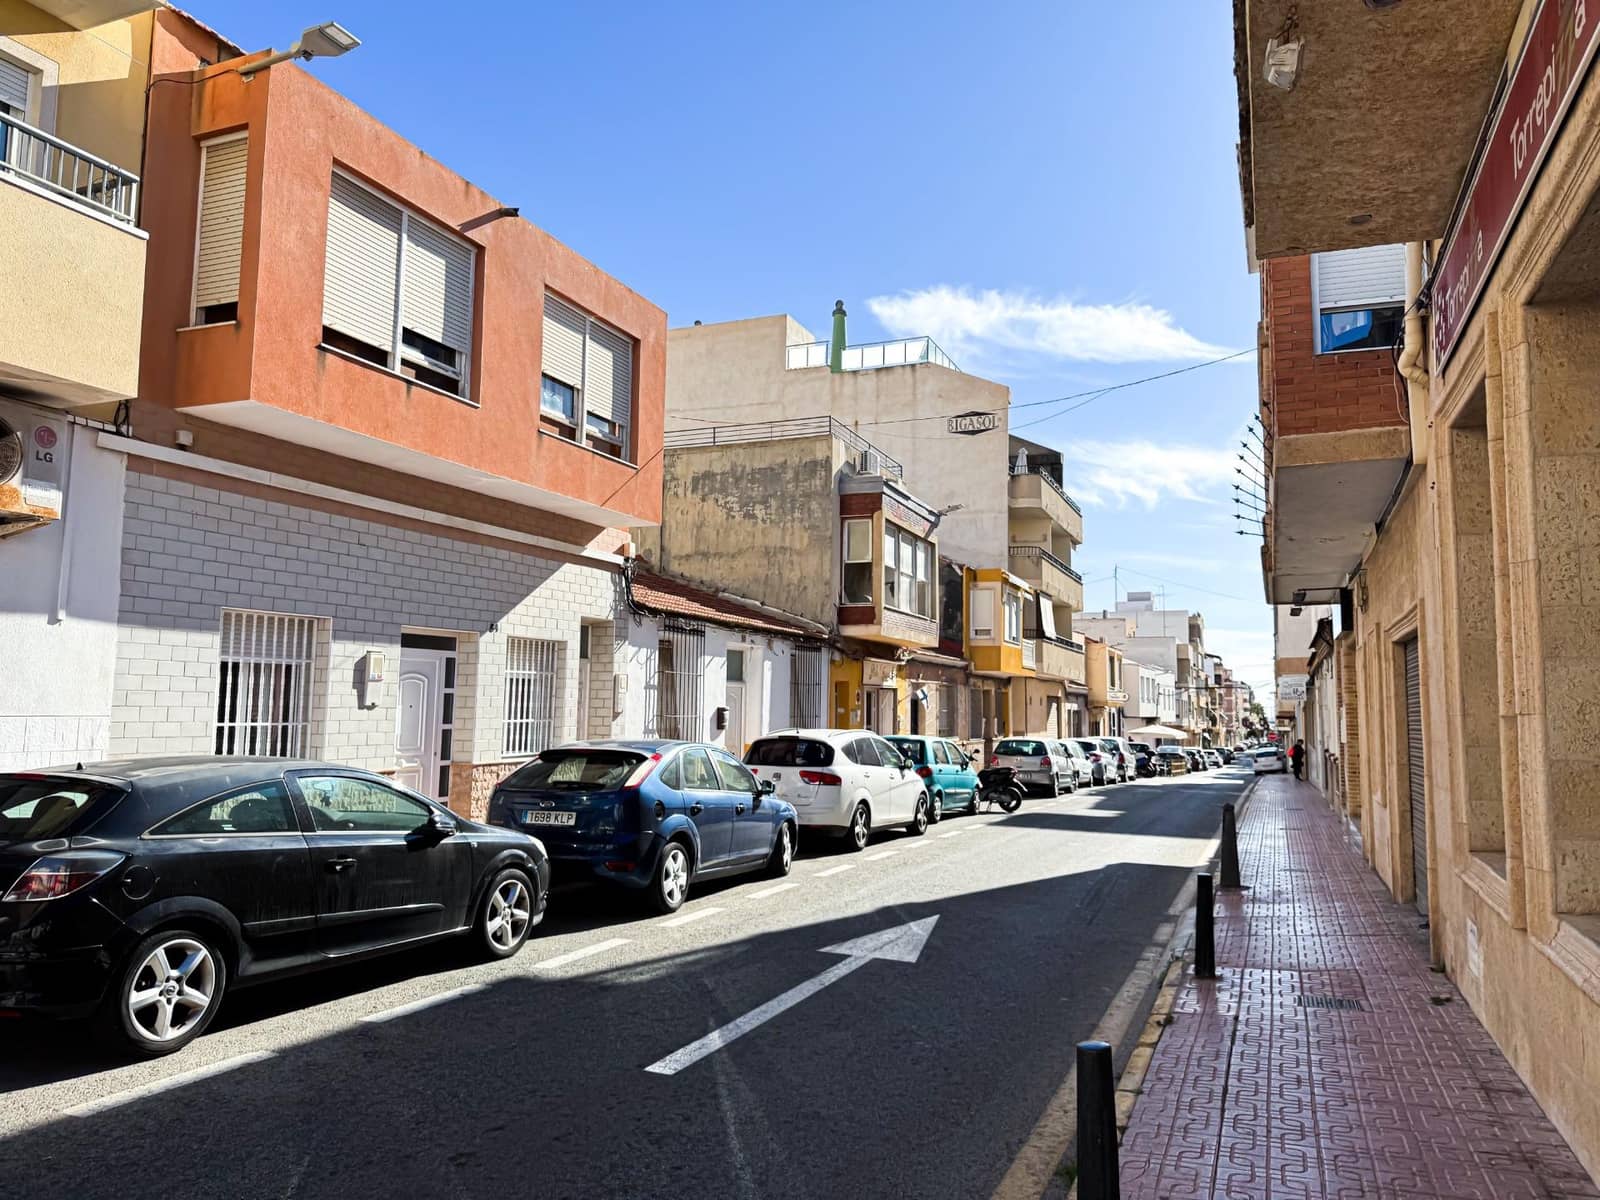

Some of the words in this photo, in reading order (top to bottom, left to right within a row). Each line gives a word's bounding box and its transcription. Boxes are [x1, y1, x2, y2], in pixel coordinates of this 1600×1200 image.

[947, 415, 999, 432] BIGASOL
[36, 450, 53, 463] LG
[554, 813, 573, 824] KLP
